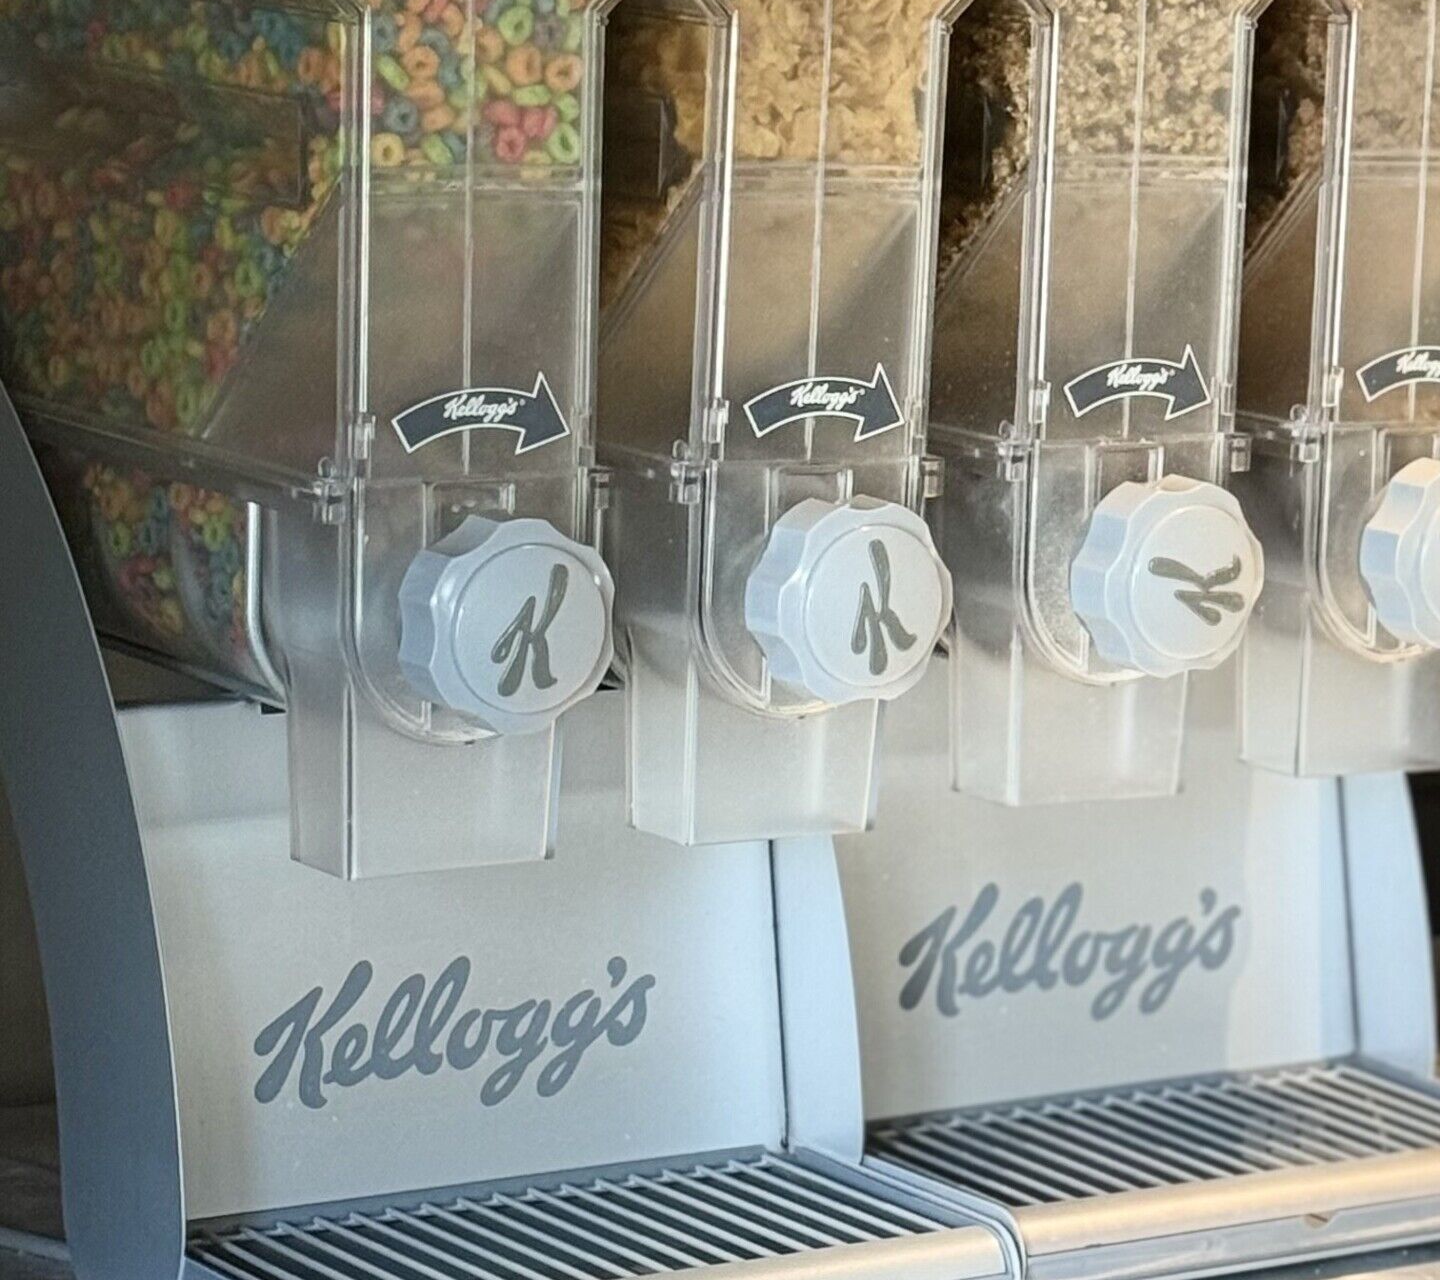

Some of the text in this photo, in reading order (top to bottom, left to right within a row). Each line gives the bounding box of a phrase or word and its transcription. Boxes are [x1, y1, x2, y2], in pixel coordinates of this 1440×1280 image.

[442, 392, 519, 423] Kellogg's
[898, 881, 1241, 1022] Kellogg's
[254, 955, 656, 1110] Kellogg's
